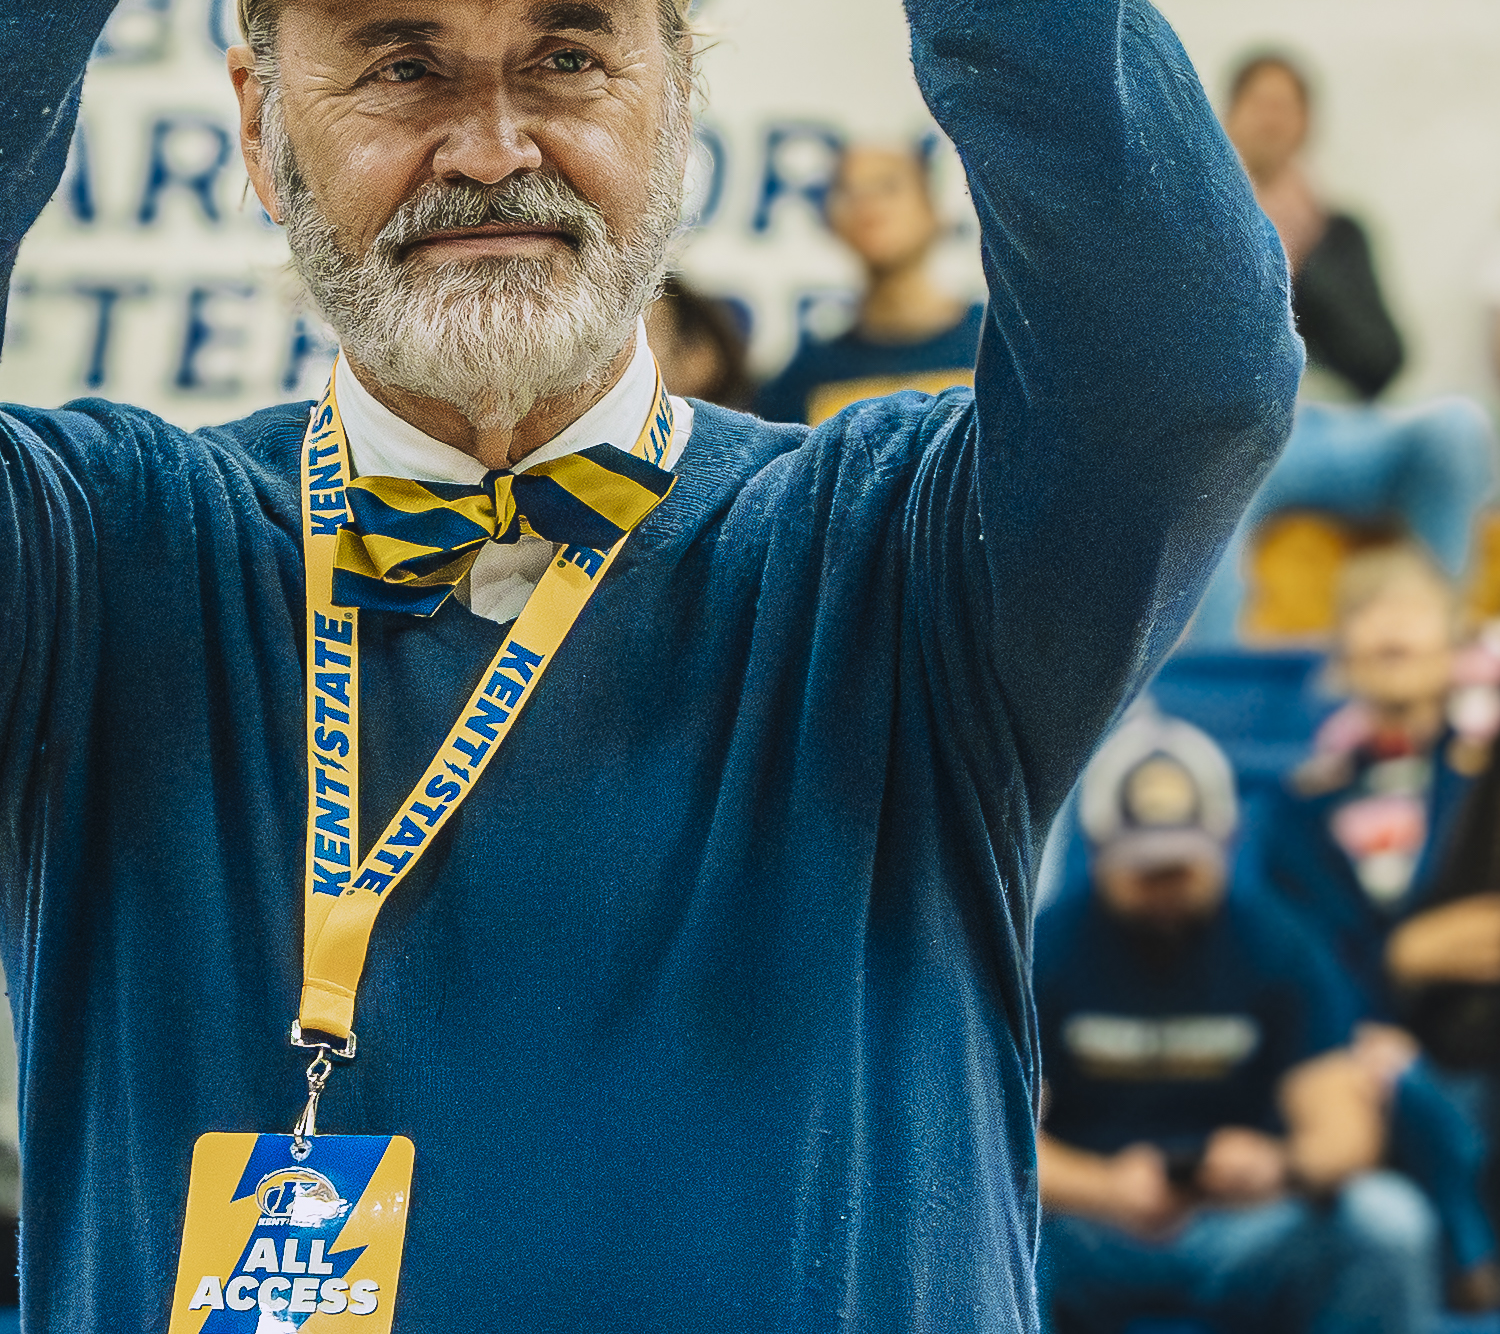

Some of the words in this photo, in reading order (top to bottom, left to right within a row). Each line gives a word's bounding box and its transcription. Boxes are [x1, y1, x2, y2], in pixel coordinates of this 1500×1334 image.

[309, 443, 348, 537] KENT
[314, 611, 353, 758] STATE
[452, 641, 545, 768] KENT
[313, 767, 352, 897] KENT
[353, 773, 461, 897] STATE
[188, 1276, 380, 1315] ACCESS
[242, 1238, 334, 1275] ALL
